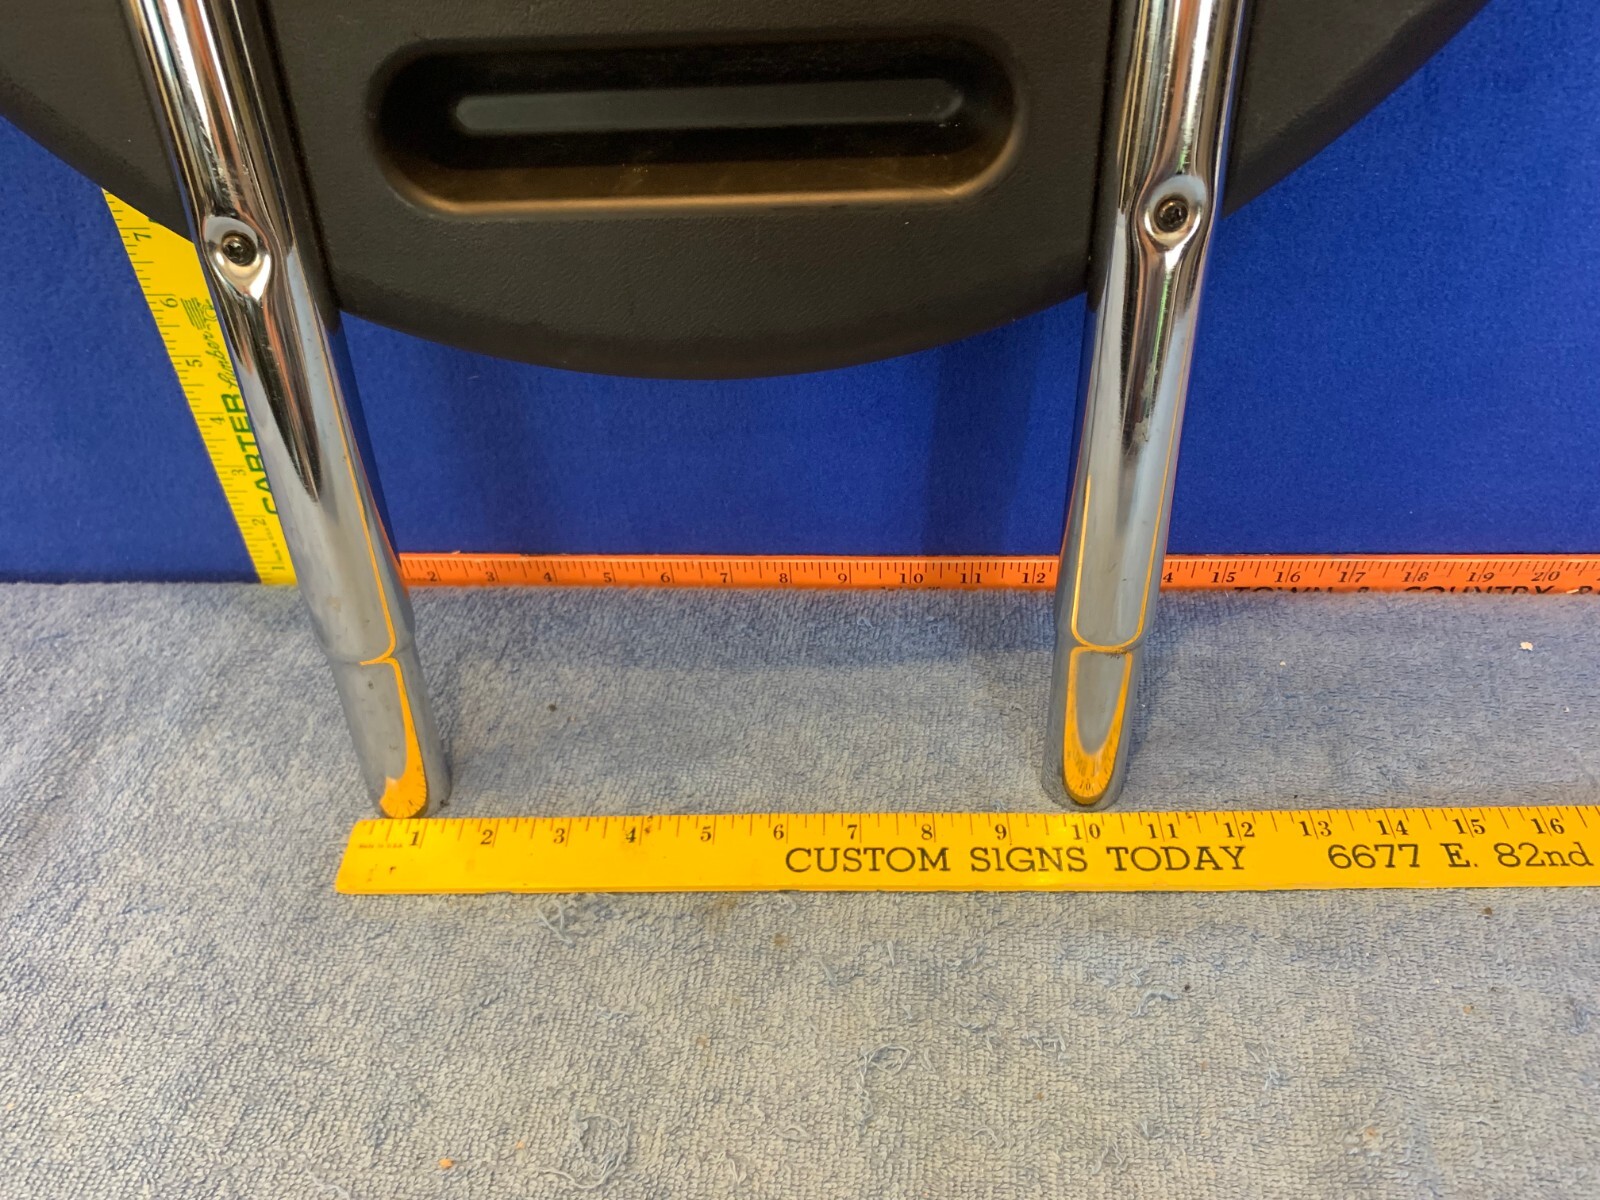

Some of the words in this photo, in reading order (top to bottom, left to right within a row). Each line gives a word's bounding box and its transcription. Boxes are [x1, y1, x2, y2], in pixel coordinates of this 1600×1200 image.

[133, 231, 152, 242] 7
[160, 297, 179, 308] 6
[186, 358, 203, 367] 5
[209, 416, 225, 425] 4
[231, 468, 247, 476] 3
[251, 517, 267, 526] 2
[427, 571, 438, 582] 2
[485, 571, 495, 582] 3
[544, 572, 553, 582] 4
[603, 572, 612, 583] 5
[660, 572, 670, 583] 6
[720, 572, 729, 583] 7
[780, 572, 788, 583] 8
[837, 572, 848, 583] 9
[900, 572, 924, 583] 10
[960, 572, 983, 583] 11
[1021, 572, 1046, 583] 12
[1211, 572, 1237, 583] 15
[1274, 571, 1301, 583] 16
[1338, 571, 1366, 583] 17
[1401, 571, 1429, 583] 18
[1466, 571, 1496, 583] 19
[1530, 571, 1561, 582] 20
[410, 831, 420, 846] 1
[480, 829, 494, 845] 2
[553, 828, 566, 844] 3
[624, 827, 637, 843] 4
[701, 826, 712, 842] 5
[773, 825, 785, 840] 6
[847, 824, 858, 840] 7
[920, 824, 933, 840] 8
[995, 824, 1007, 840] 9
[1072, 824, 1100, 840] 10
[1149, 823, 1178, 839] 11
[1223, 821, 1255, 838] 12
[1300, 820, 1332, 837] 13
[1376, 819, 1409, 836] 14
[1453, 818, 1486, 835] 15
[1531, 818, 1565, 835] 16
[785, 847, 951, 872] CUSTOM
[970, 847, 1088, 872] SIGNS
[1106, 846, 1246, 871] TODAY
[1328, 843, 1420, 869] 6677
[1440, 843, 1478, 868] E.
[1493, 842, 1593, 869] 82nd
